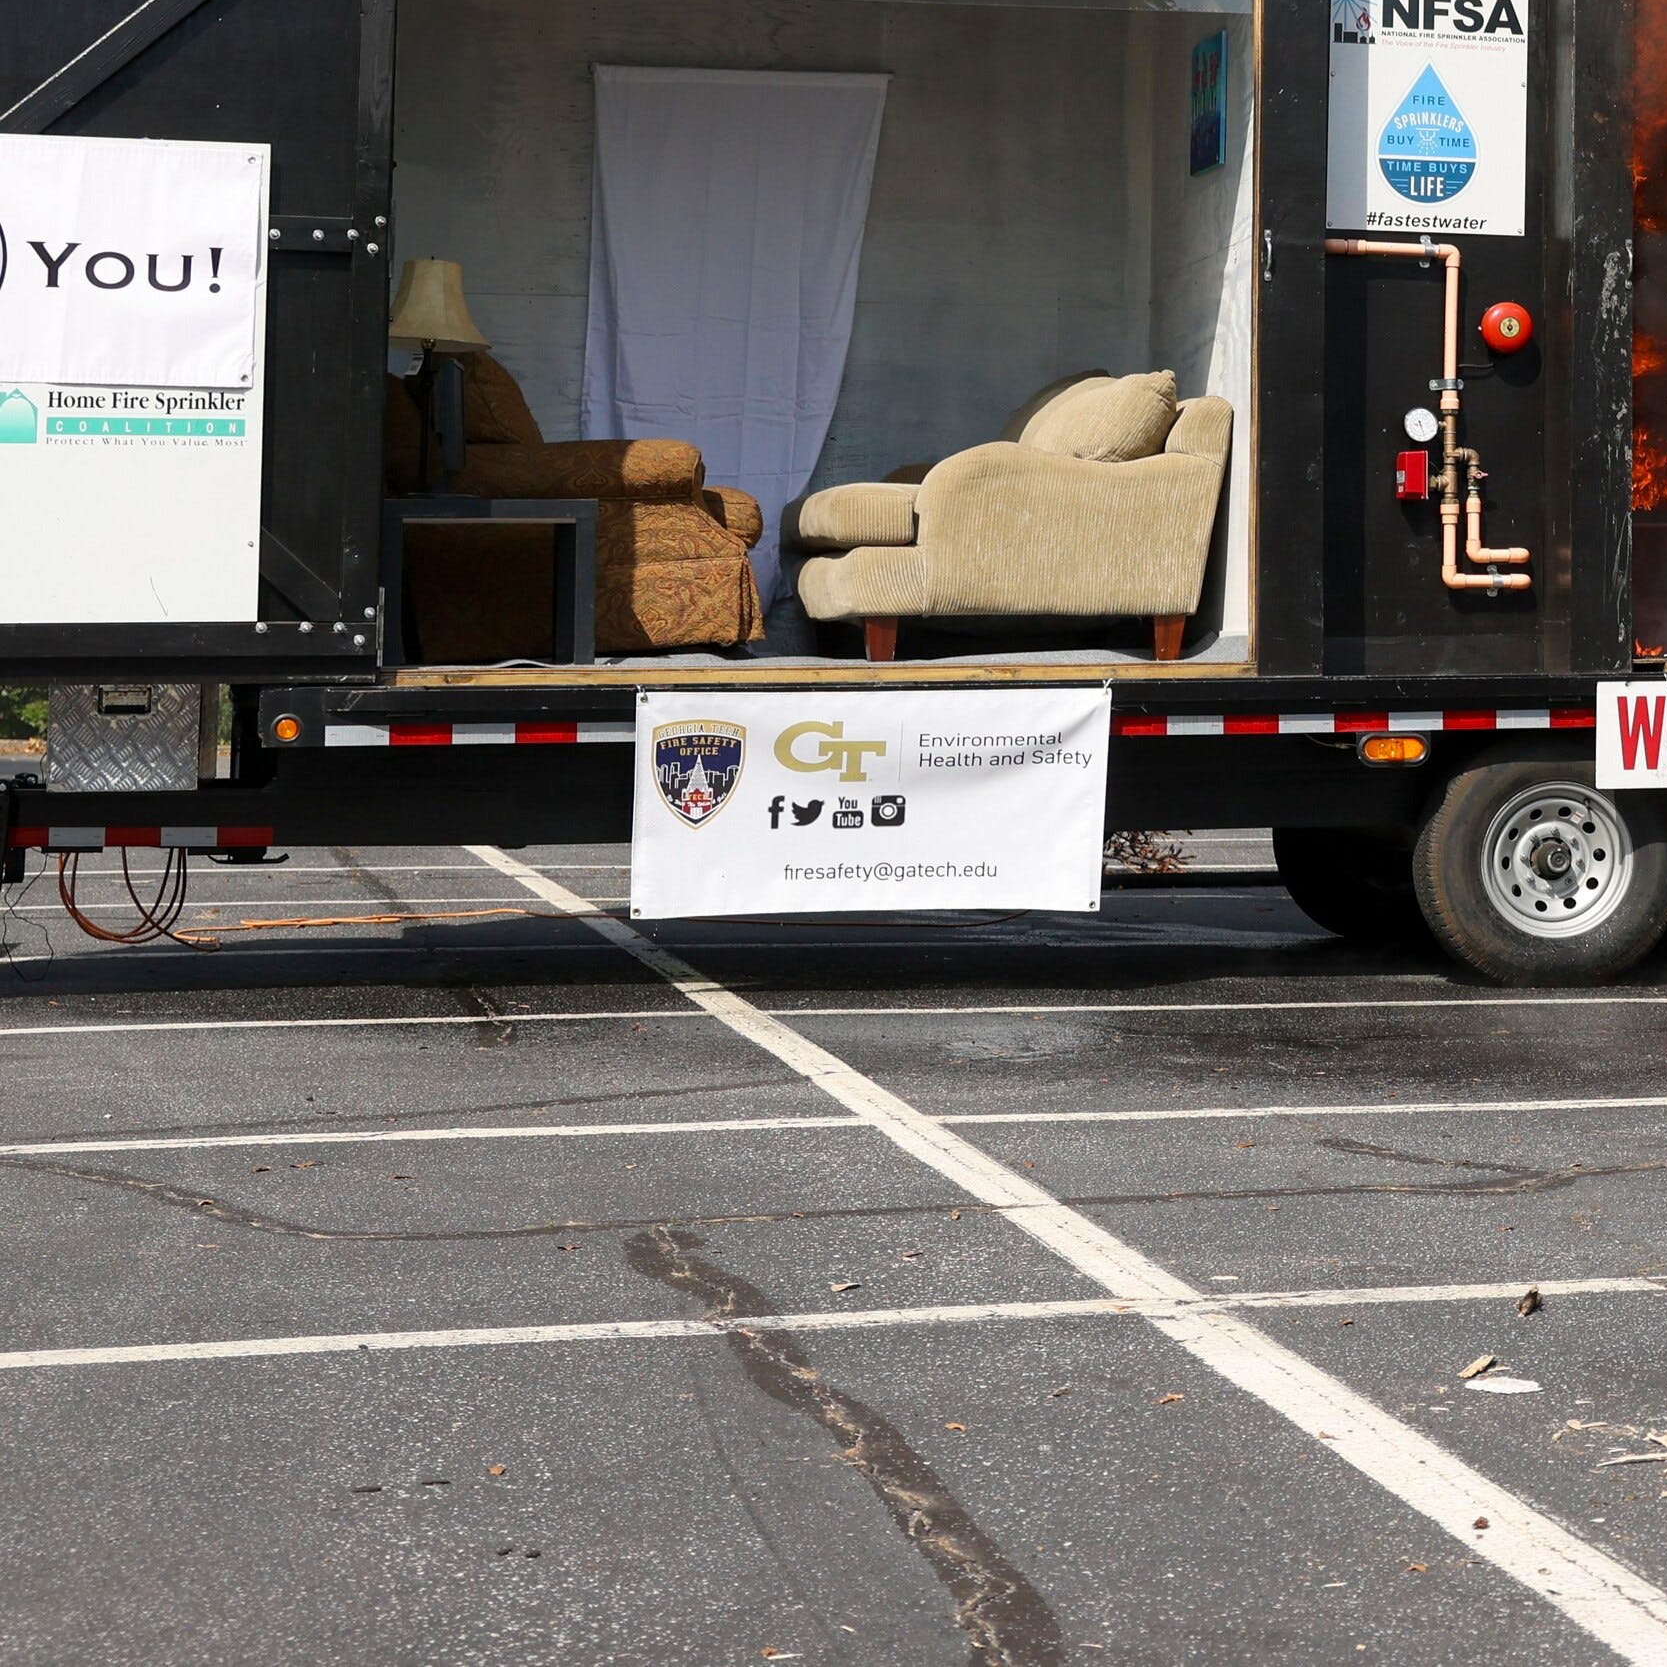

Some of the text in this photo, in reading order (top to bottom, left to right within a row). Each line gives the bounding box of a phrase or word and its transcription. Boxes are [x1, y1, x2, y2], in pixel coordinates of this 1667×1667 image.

[1437, 33, 1477, 41] SPRINKLER
[1479, 36, 1526, 44] ASSOCIATION
[1413, 95, 1445, 106] FIRE
[1394, 111, 1465, 133] SPRINKLERS
[1387, 135, 1470, 148] BUY TIME
[1387, 161, 1468, 174] TIME BUYS
[1410, 176, 1445, 197] LIFE
[1366, 211, 1487, 230] #fastestwater
[47, 391, 245, 415] Home Fire Sprinkler
[56, 420, 237, 434] COALITION
[46, 437, 245, 447] Protect What You Value Most
[660, 736, 737, 750] FIRE SAFETY
[919, 731, 1063, 748] Environmental
[680, 746, 719, 756] OFFICE
[774, 720, 887, 783] GT
[919, 748, 1093, 769] Health and Safety
[838, 796, 859, 810] You
[835, 812, 862, 827] Tube
[784, 861, 998, 882] firesafety@gatech.edu
